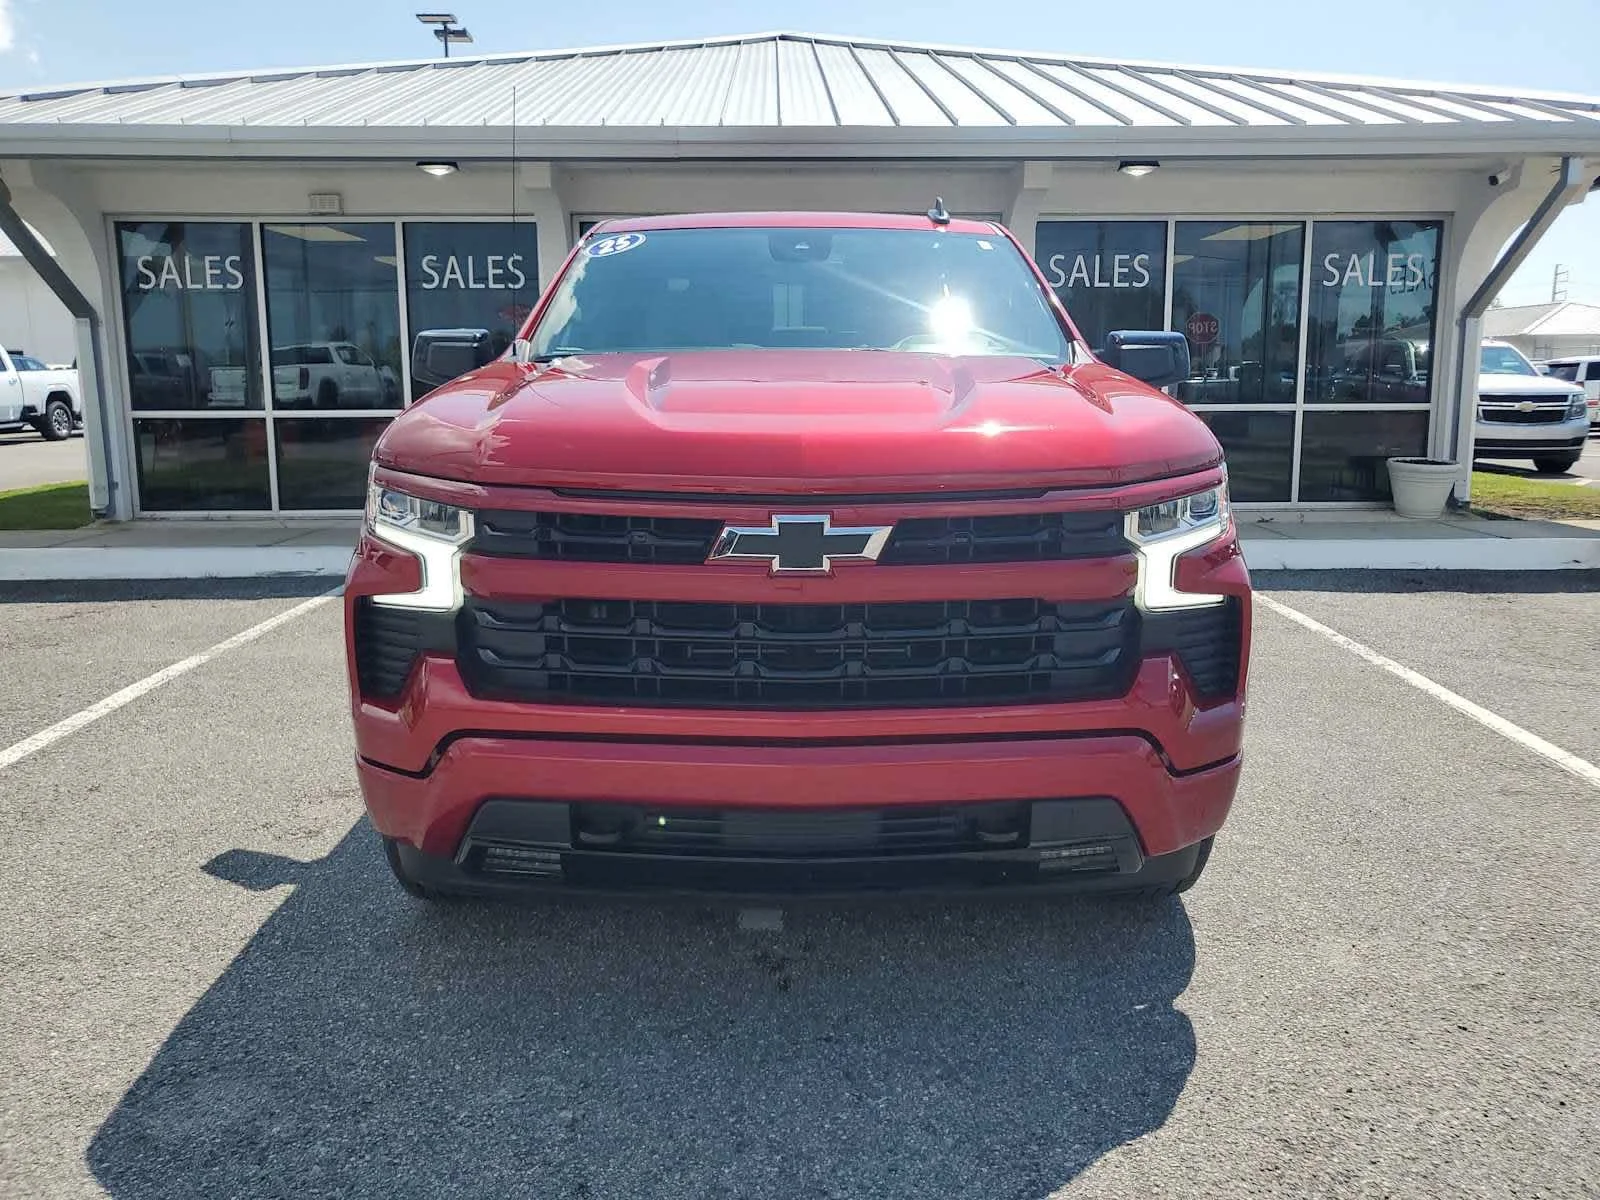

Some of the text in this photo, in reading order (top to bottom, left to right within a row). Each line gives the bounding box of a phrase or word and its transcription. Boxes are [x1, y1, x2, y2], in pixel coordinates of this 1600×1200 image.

[598, 235, 631, 254] 25
[137, 255, 243, 290] SALES
[421, 255, 526, 289] SALES
[1048, 254, 1150, 288] SALES
[1322, 253, 1424, 287] SALES
